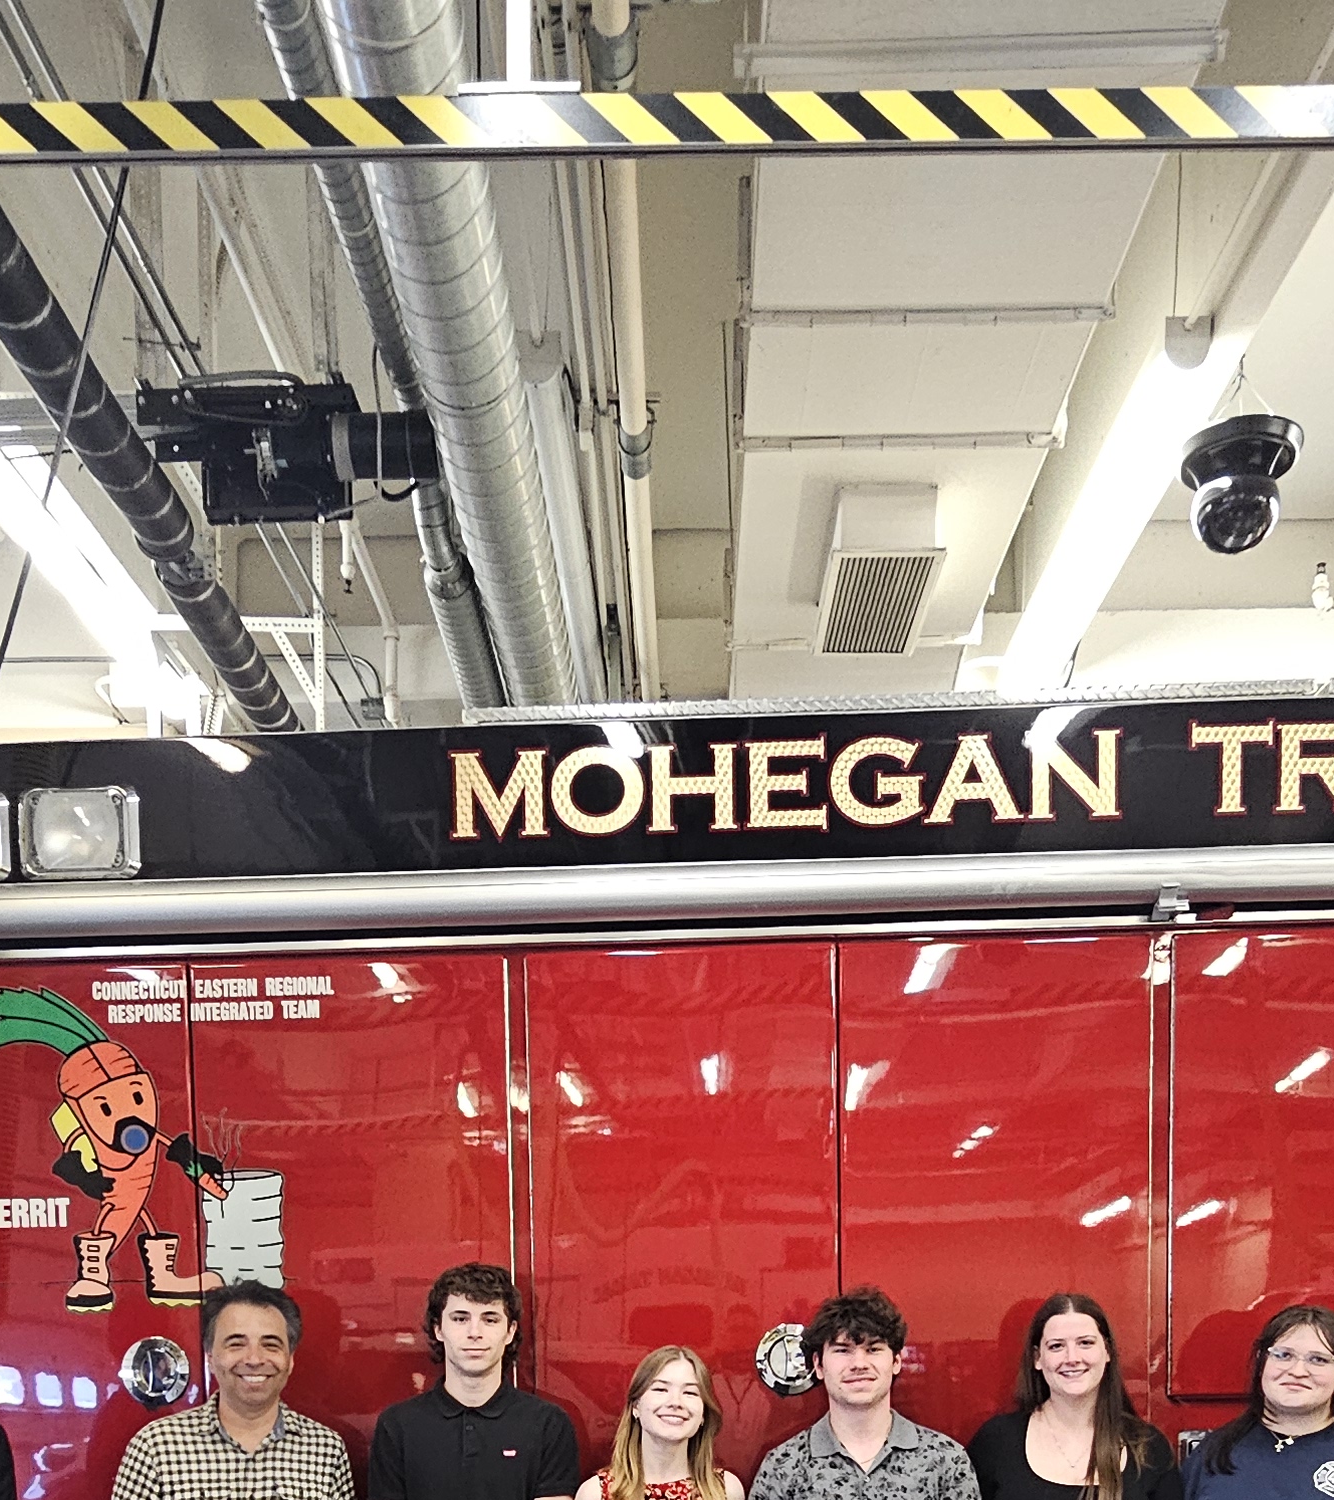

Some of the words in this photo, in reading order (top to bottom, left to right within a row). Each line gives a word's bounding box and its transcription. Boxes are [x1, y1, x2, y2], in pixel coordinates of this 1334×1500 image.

[447, 726, 1122, 844] MOHEGAN
[91, 979, 186, 1001] CONNECTICUT
[194, 978, 257, 999] EASTERN
[265, 976, 334, 997] REGIONAL
[108, 1001, 181, 1024] RESPONSE
[190, 1001, 273, 1022] INTEGRATED
[282, 999, 320, 1019] TEAM
